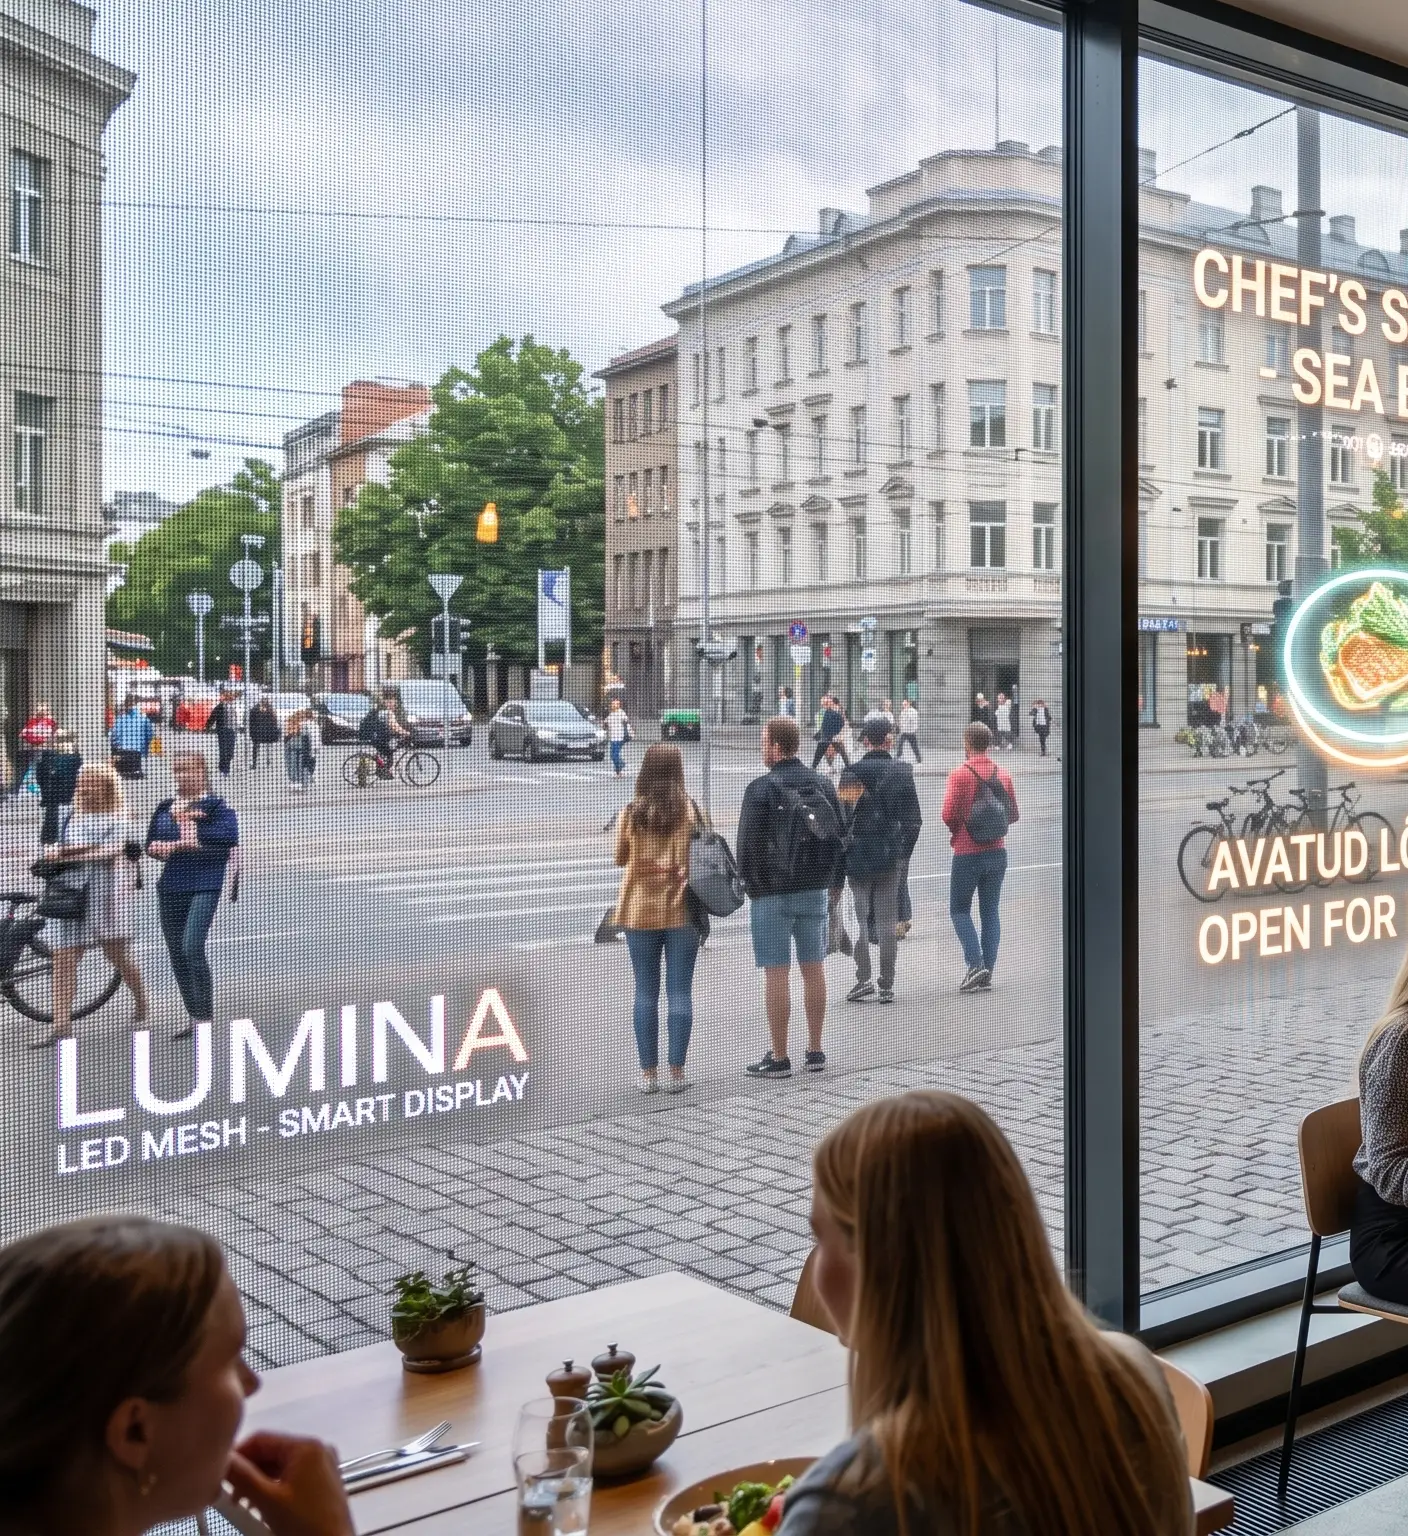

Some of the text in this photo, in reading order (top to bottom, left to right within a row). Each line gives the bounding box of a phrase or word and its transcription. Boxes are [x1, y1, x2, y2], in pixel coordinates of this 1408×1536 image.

[1193, 248, 1367, 336] CHEF'S
[1291, 348, 1385, 415] SEA
[1207, 830, 1368, 891] AVATUD
[1198, 903, 1311, 965] OPEN
[1324, 894, 1397, 947] FOR
[57, 987, 530, 1130] LUMINA
[57, 1071, 530, 1175] LED MESH - SMART DISPLAY
